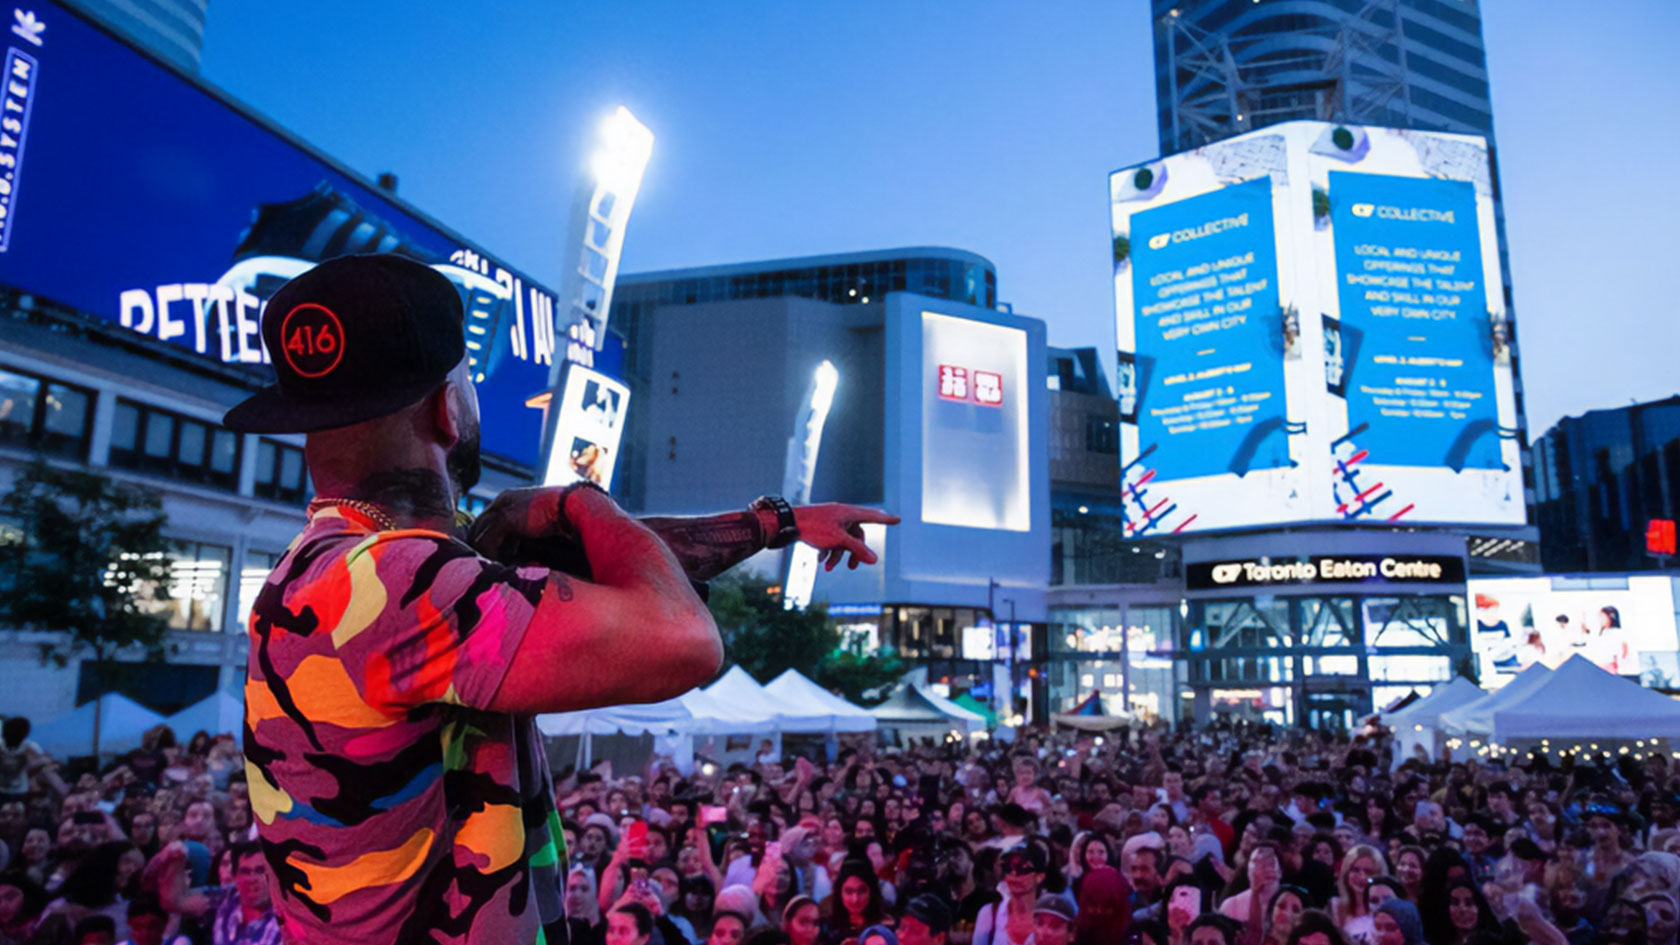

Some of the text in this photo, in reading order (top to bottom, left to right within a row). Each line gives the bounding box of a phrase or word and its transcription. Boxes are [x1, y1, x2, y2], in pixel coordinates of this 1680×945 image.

[1377, 205, 1455, 224] COLLECTIVE
[1172, 213, 1249, 243] COLLECTIVE
[287, 324, 337, 356] 416
[1243, 562, 1317, 581] Toronto
[1319, 558, 1377, 579] Eaton
[1380, 558, 1442, 579] Centre
